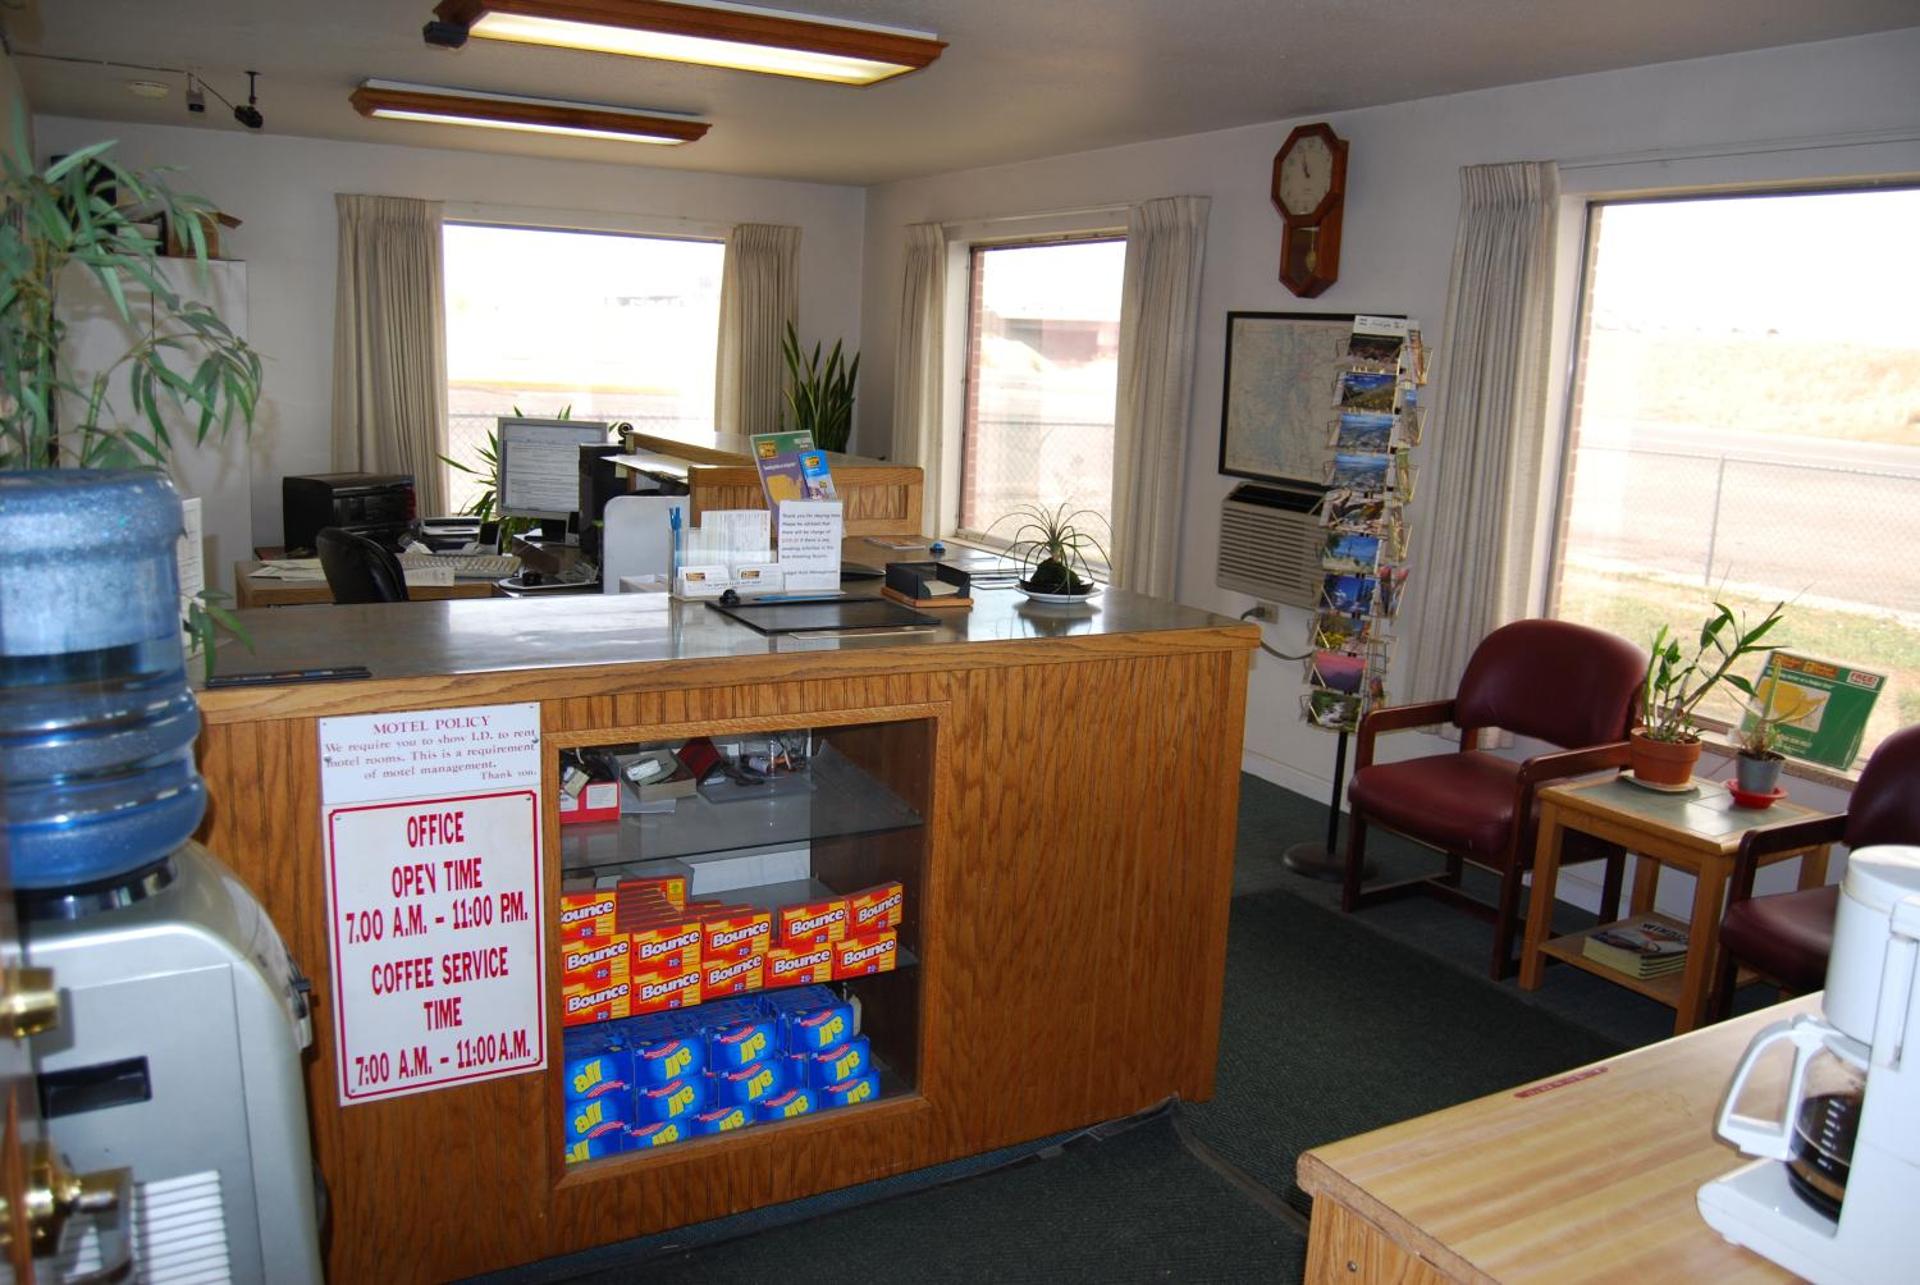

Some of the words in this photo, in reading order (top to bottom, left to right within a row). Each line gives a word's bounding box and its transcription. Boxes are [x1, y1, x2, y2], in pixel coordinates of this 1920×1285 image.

[374, 719, 428, 735] MOTEL
[436, 715, 491, 731] POLICY
[325, 743, 342, 753] We
[348, 741, 391, 753] require
[422, 737, 434, 746] to
[438, 733, 465, 745] show
[498, 730, 509, 740] to
[513, 728, 535, 739] rent
[327, 756, 360, 769] motel
[365, 754, 406, 766] rooms.
[411, 749, 438, 762] This
[442, 748, 451, 759] is
[455, 750, 462, 758] a
[467, 742, 535, 758] requirement
[363, 769, 377, 781] of
[382, 766, 415, 779] motel
[420, 761, 497, 776] management.
[481, 768, 513, 781] Thank
[407, 811, 465, 848] OFFICE
[392, 862, 436, 898] OPEN
[443, 857, 483, 892] TIME
[393, 904, 428, 938] A.M.
[452, 895, 493, 930] 11:00
[500, 891, 529, 923] P.M.
[561, 901, 614, 922] ounce
[790, 908, 845, 936] Bounce
[857, 893, 902, 923] Bounce
[640, 931, 700, 959] Bounce
[712, 922, 769, 949] Bounce
[567, 942, 628, 970] Bounce
[773, 950, 831, 974] Bounce
[842, 939, 895, 965] Bounce
[371, 957, 434, 995] COFFEE
[442, 946, 509, 985] SERVICE
[708, 955, 762, 985] Bounce
[568, 984, 629, 1012] Bounce
[641, 972, 700, 1000] Bounce
[423, 997, 463, 1031] TIME
[819, 1016, 844, 1048] all
[355, 1053, 390, 1086] 7:00
[398, 1046, 433, 1080] A.M.
[456, 1034, 496, 1069] 11:00
[498, 1029, 531, 1062] A.M.
[664, 1047, 692, 1080] all
[740, 1032, 767, 1065] all
[573, 1060, 602, 1093] all
[835, 1051, 861, 1081] all
[748, 1069, 774, 1101] all
[574, 1100, 603, 1134] all
[668, 1086, 695, 1118] all
